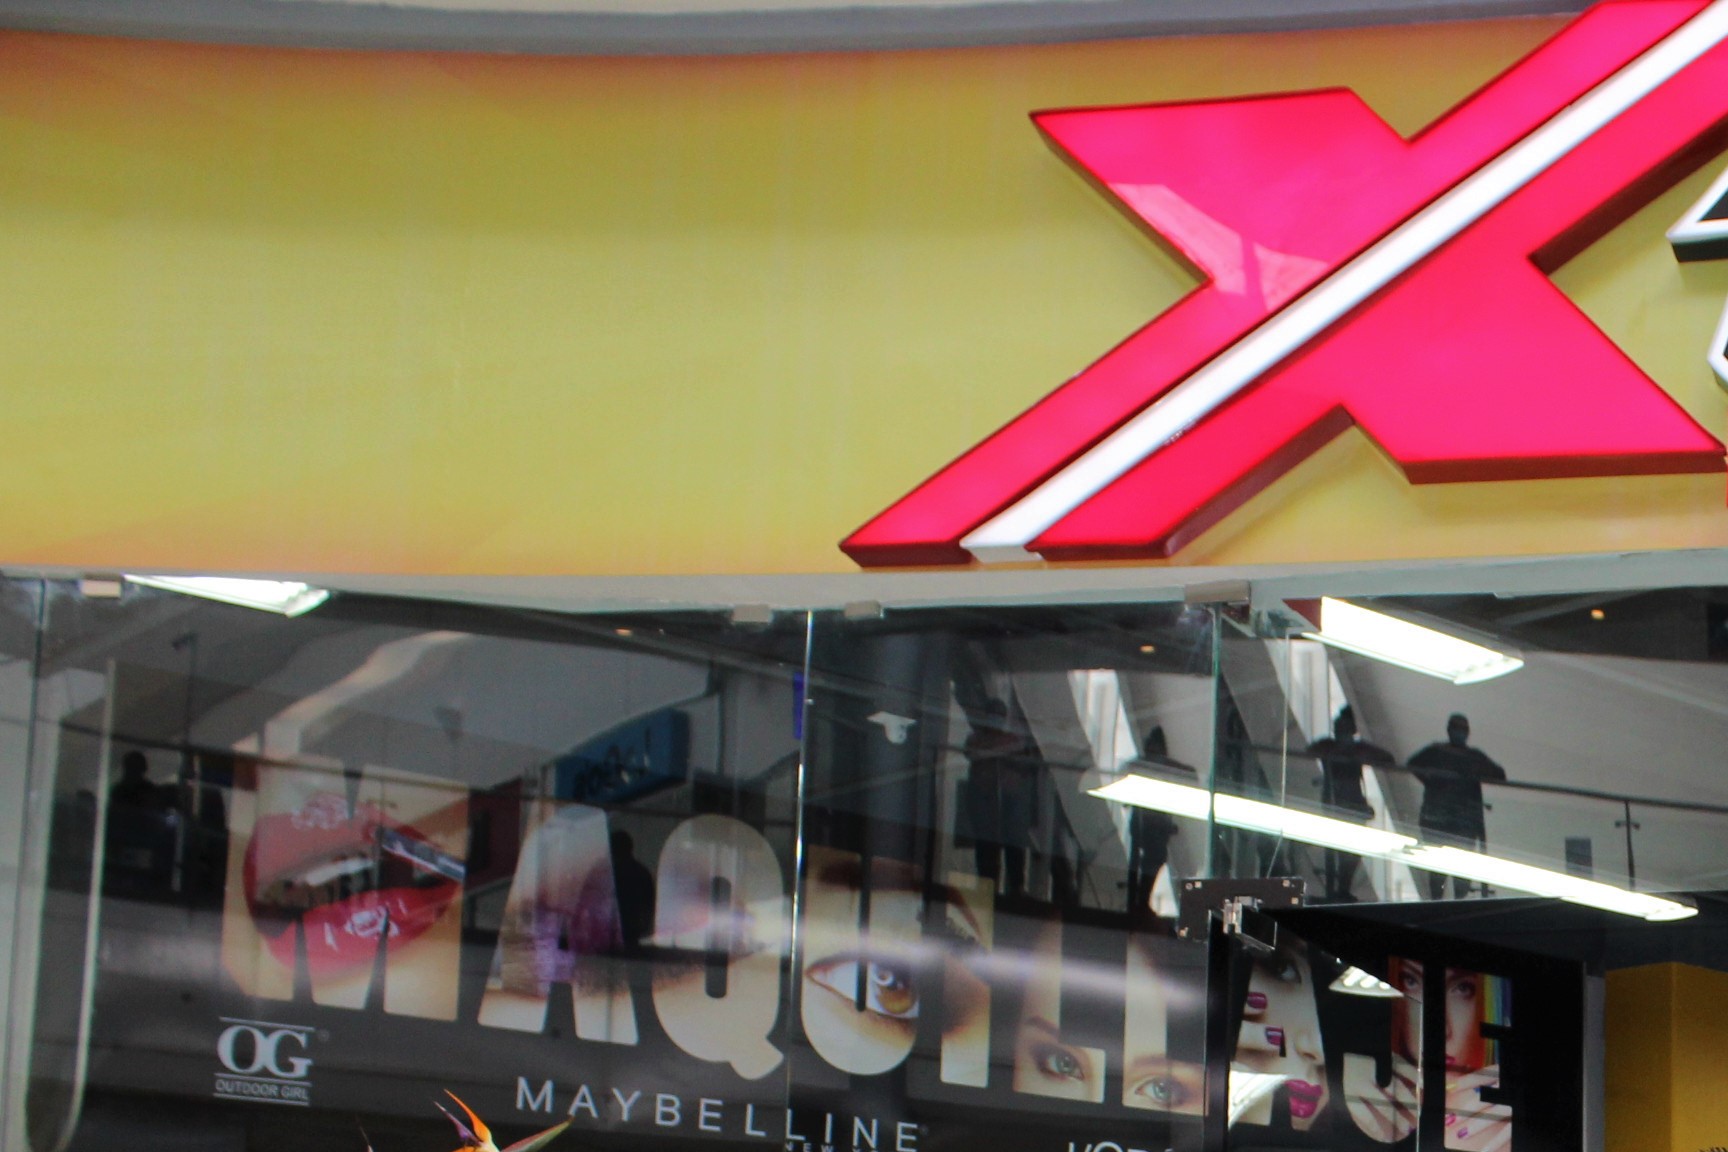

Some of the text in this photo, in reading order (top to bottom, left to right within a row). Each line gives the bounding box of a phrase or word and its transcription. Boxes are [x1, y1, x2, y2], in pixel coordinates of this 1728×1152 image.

[216, 1023, 314, 1078] OG
[214, 1077, 309, 1101] OUTDOOR GIRL
